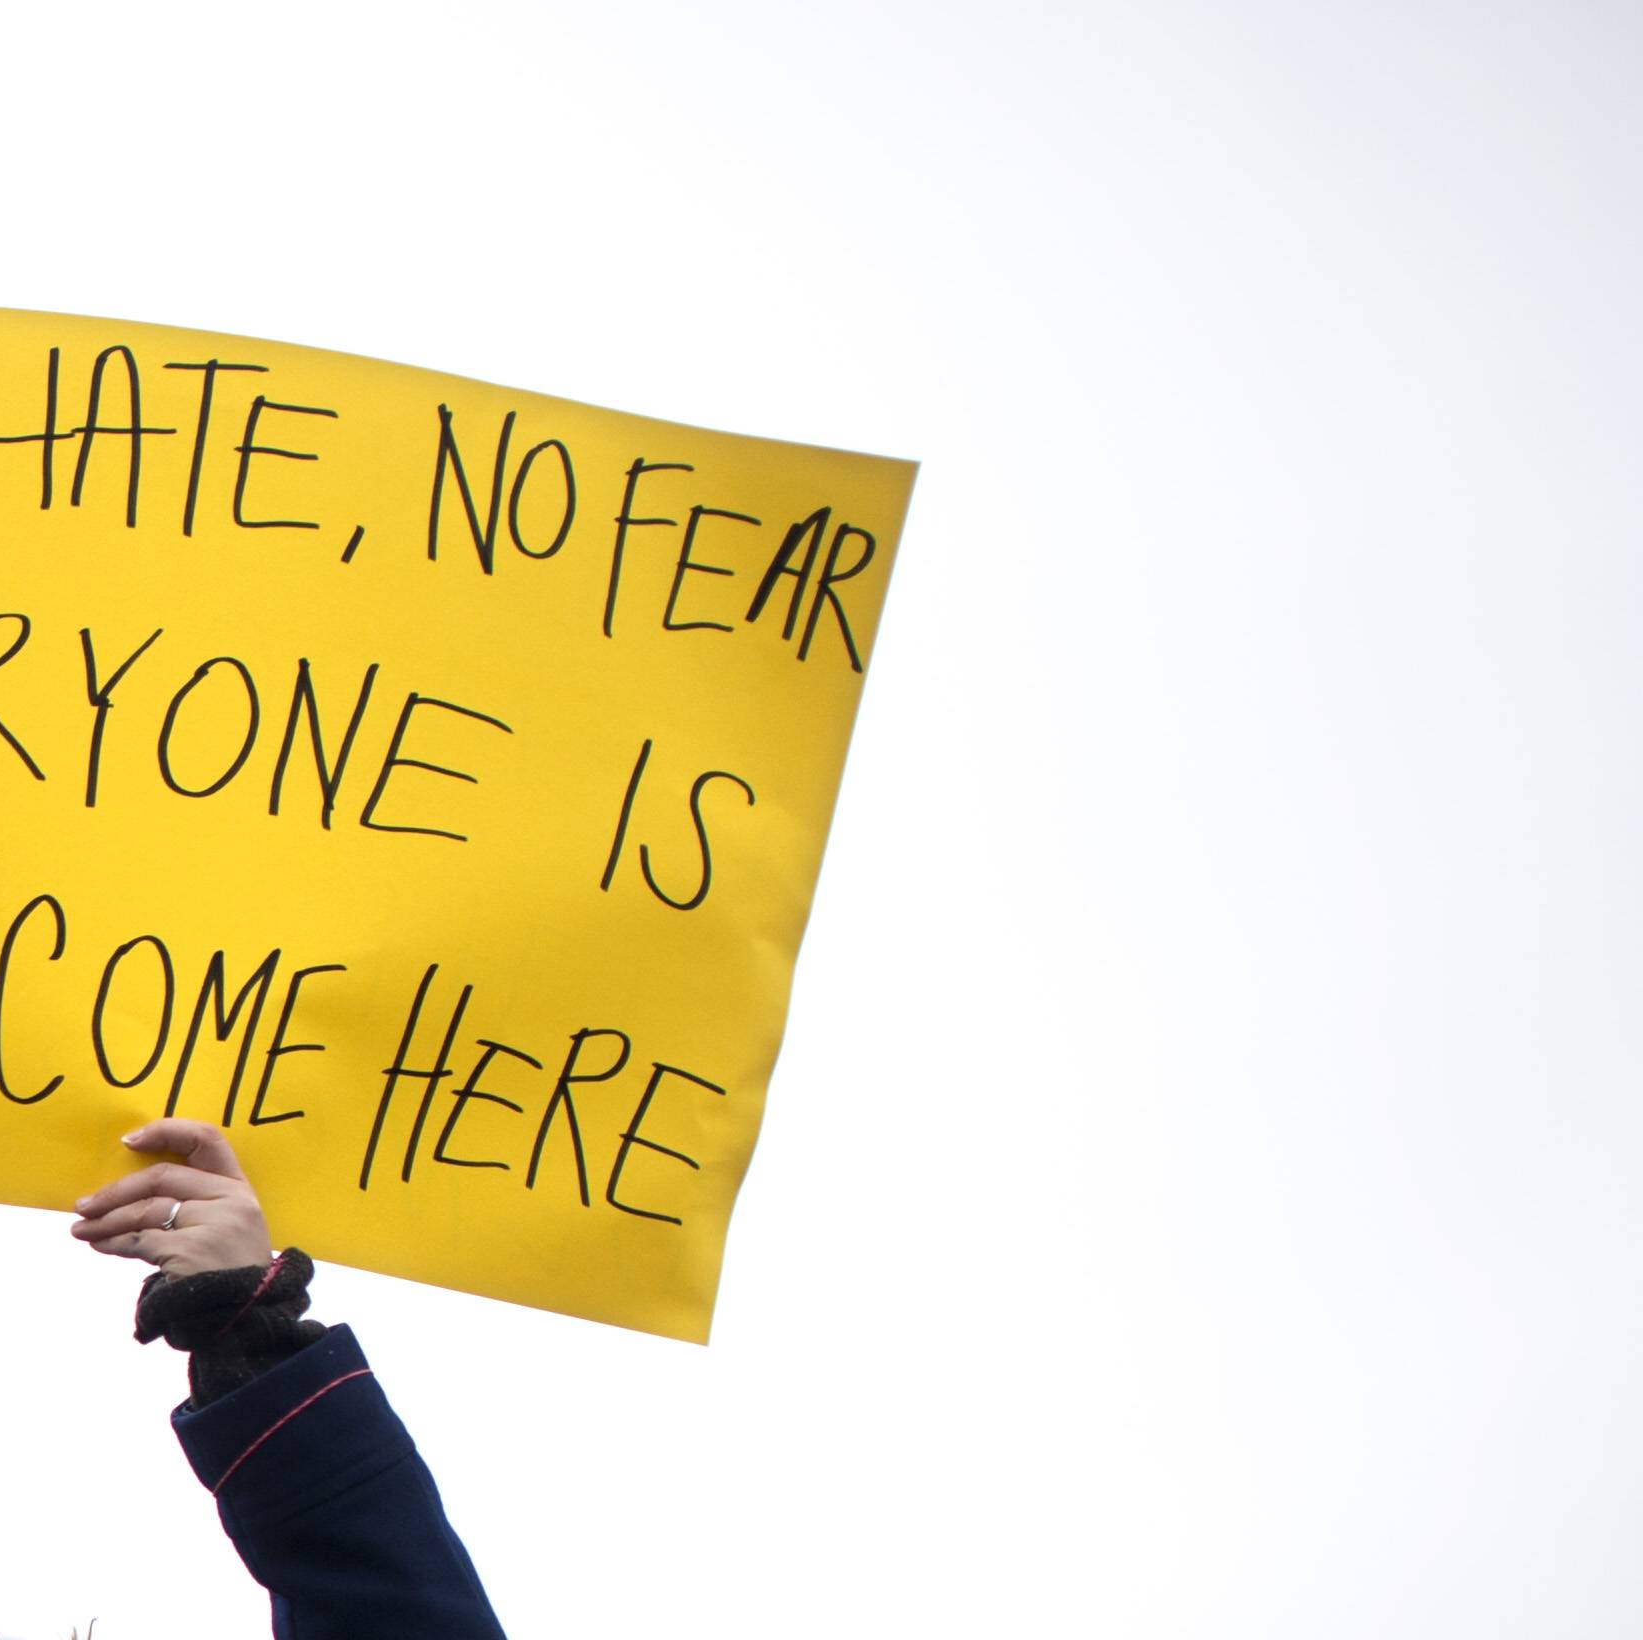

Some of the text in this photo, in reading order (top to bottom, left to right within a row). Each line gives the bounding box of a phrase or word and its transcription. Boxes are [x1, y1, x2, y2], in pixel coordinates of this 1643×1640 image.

[429, 404, 575, 575] NO
[604, 458, 876, 673] FEAR
[601, 740, 755, 910] IS
[360, 964, 725, 1225] HERE
